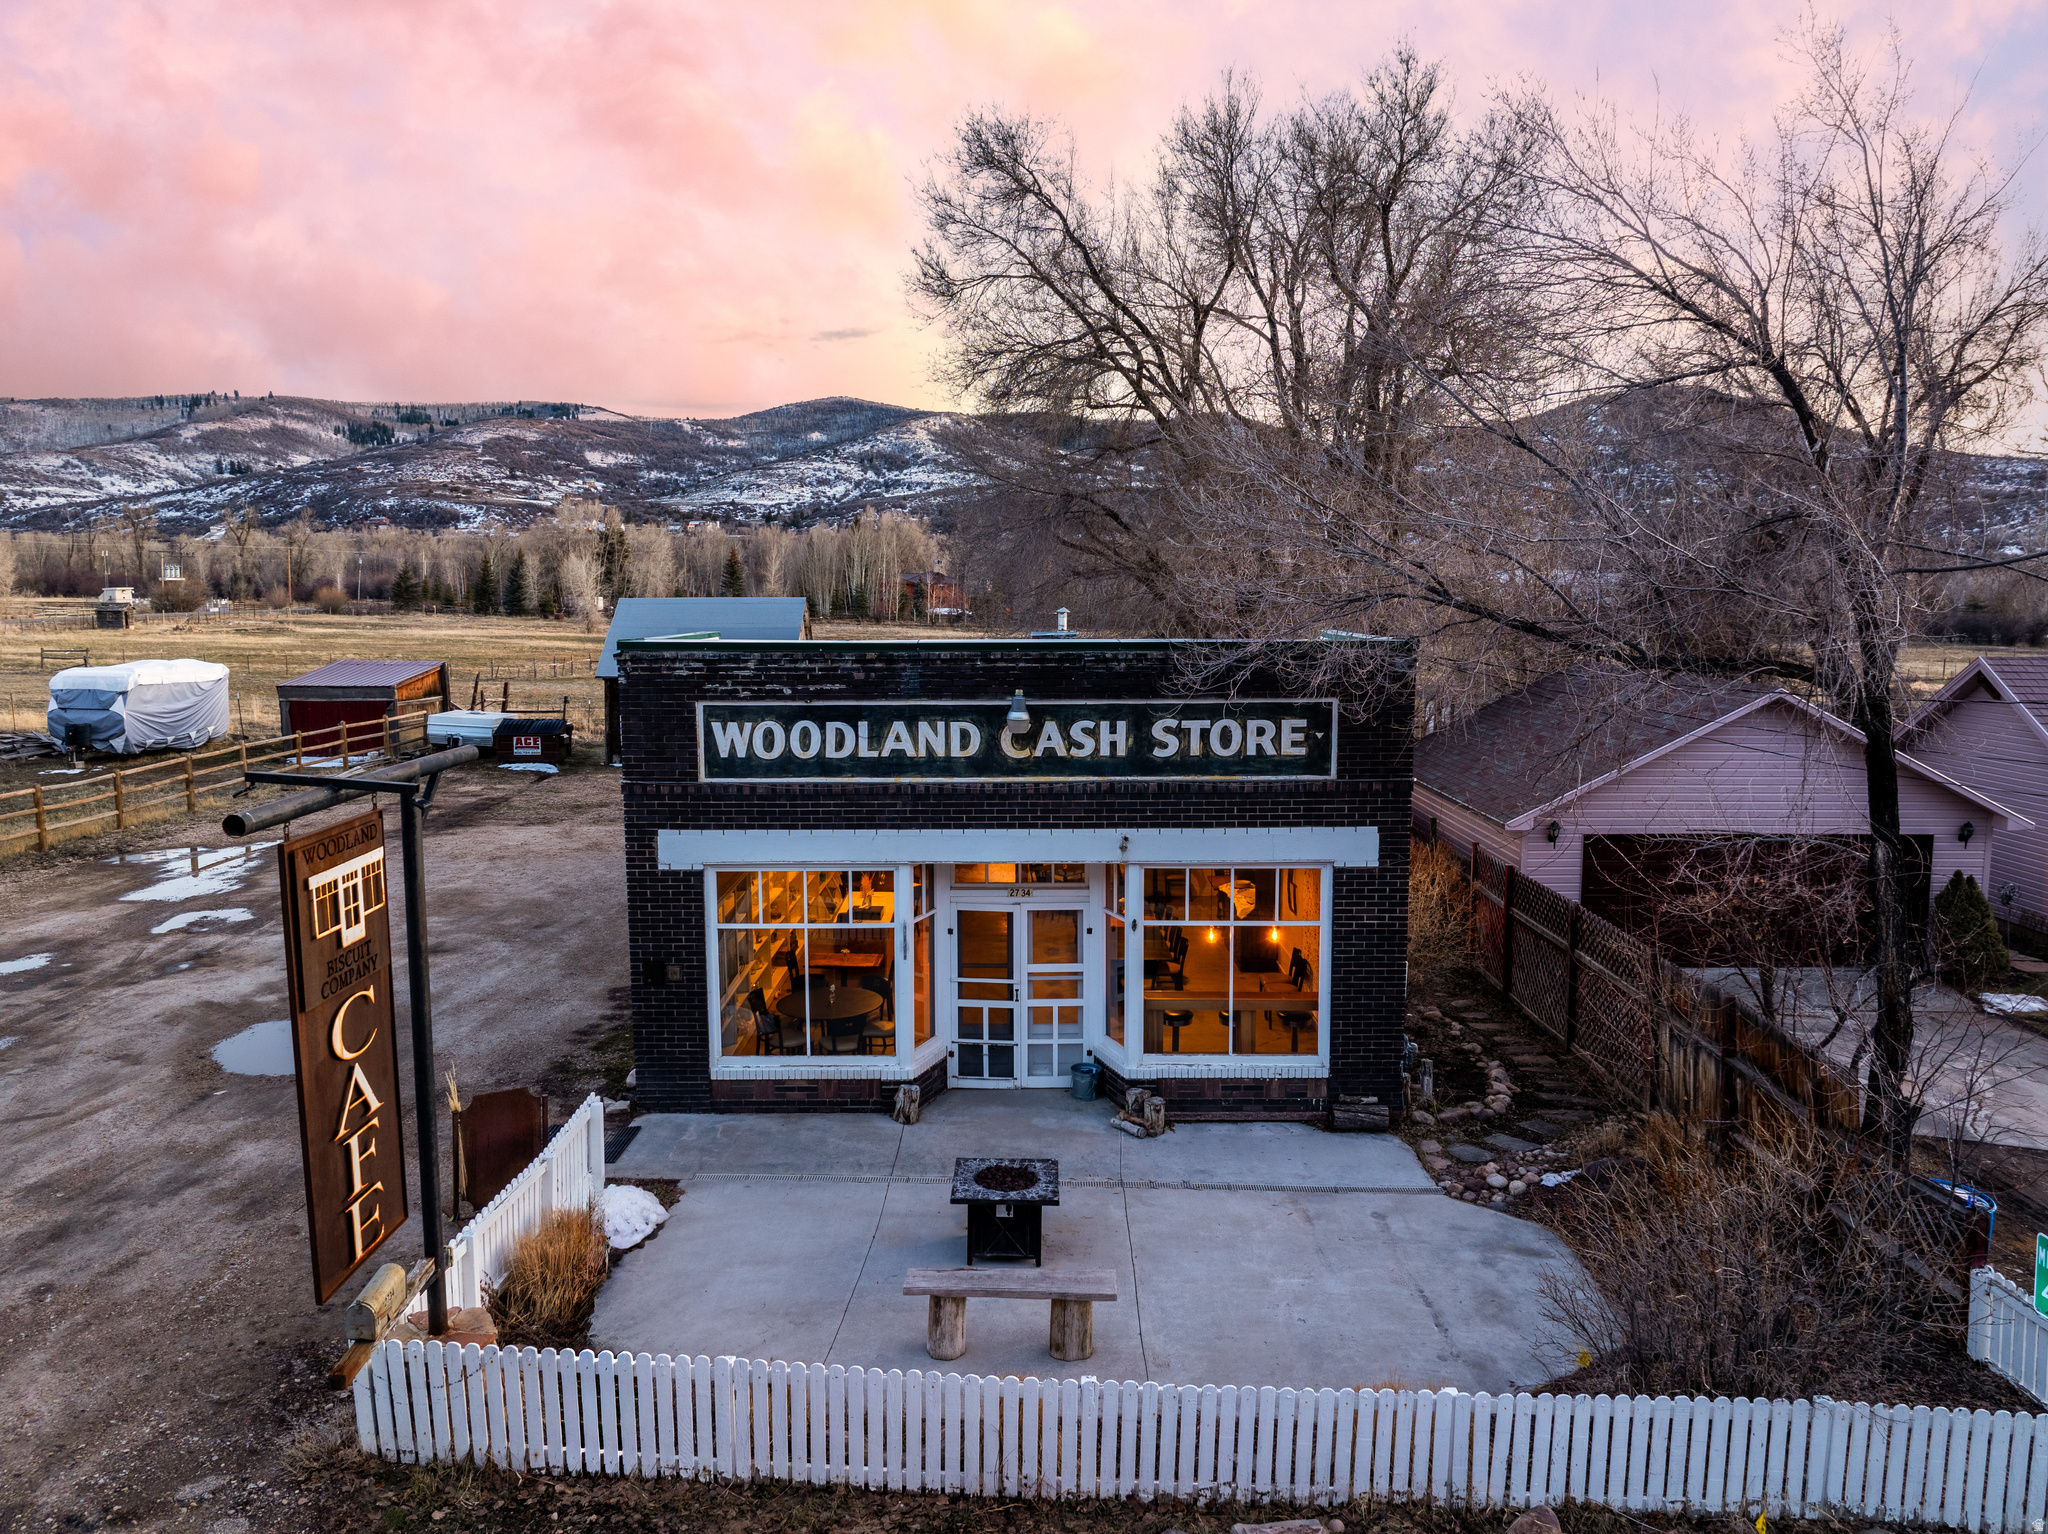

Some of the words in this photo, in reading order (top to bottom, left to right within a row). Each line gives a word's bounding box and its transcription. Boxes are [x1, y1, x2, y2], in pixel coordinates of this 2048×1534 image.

[515, 736, 540, 746] ACE
[709, 719, 981, 760] WOODLAND
[1001, 718, 1127, 759] CASH
[1151, 718, 1309, 758] STORE
[302, 823, 378, 866] WOODLAND
[321, 953, 379, 1000] COMPANY
[326, 939, 372, 978] BISCUIT
[332, 984, 385, 1266] CAFE
